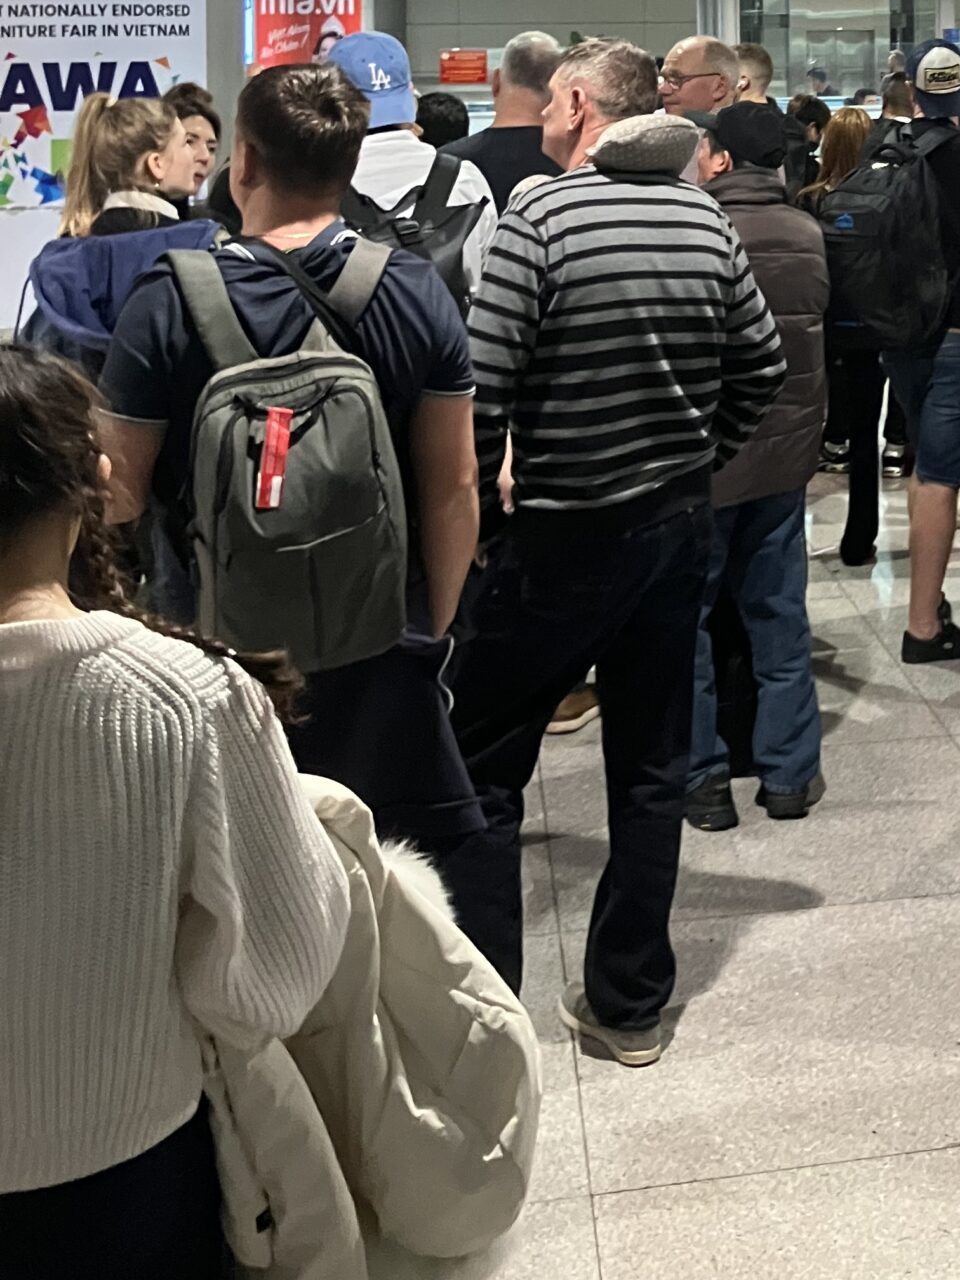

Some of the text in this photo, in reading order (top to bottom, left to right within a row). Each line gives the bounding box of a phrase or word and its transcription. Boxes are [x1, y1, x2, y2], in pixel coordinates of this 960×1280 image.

[8, 4, 107, 17] NATIONALLY
[112, 4, 190, 17] ENDORSED
[1, 24, 190, 38] NITURE FAIR IN VIETNAM
[368, 62, 391, 91] LA
